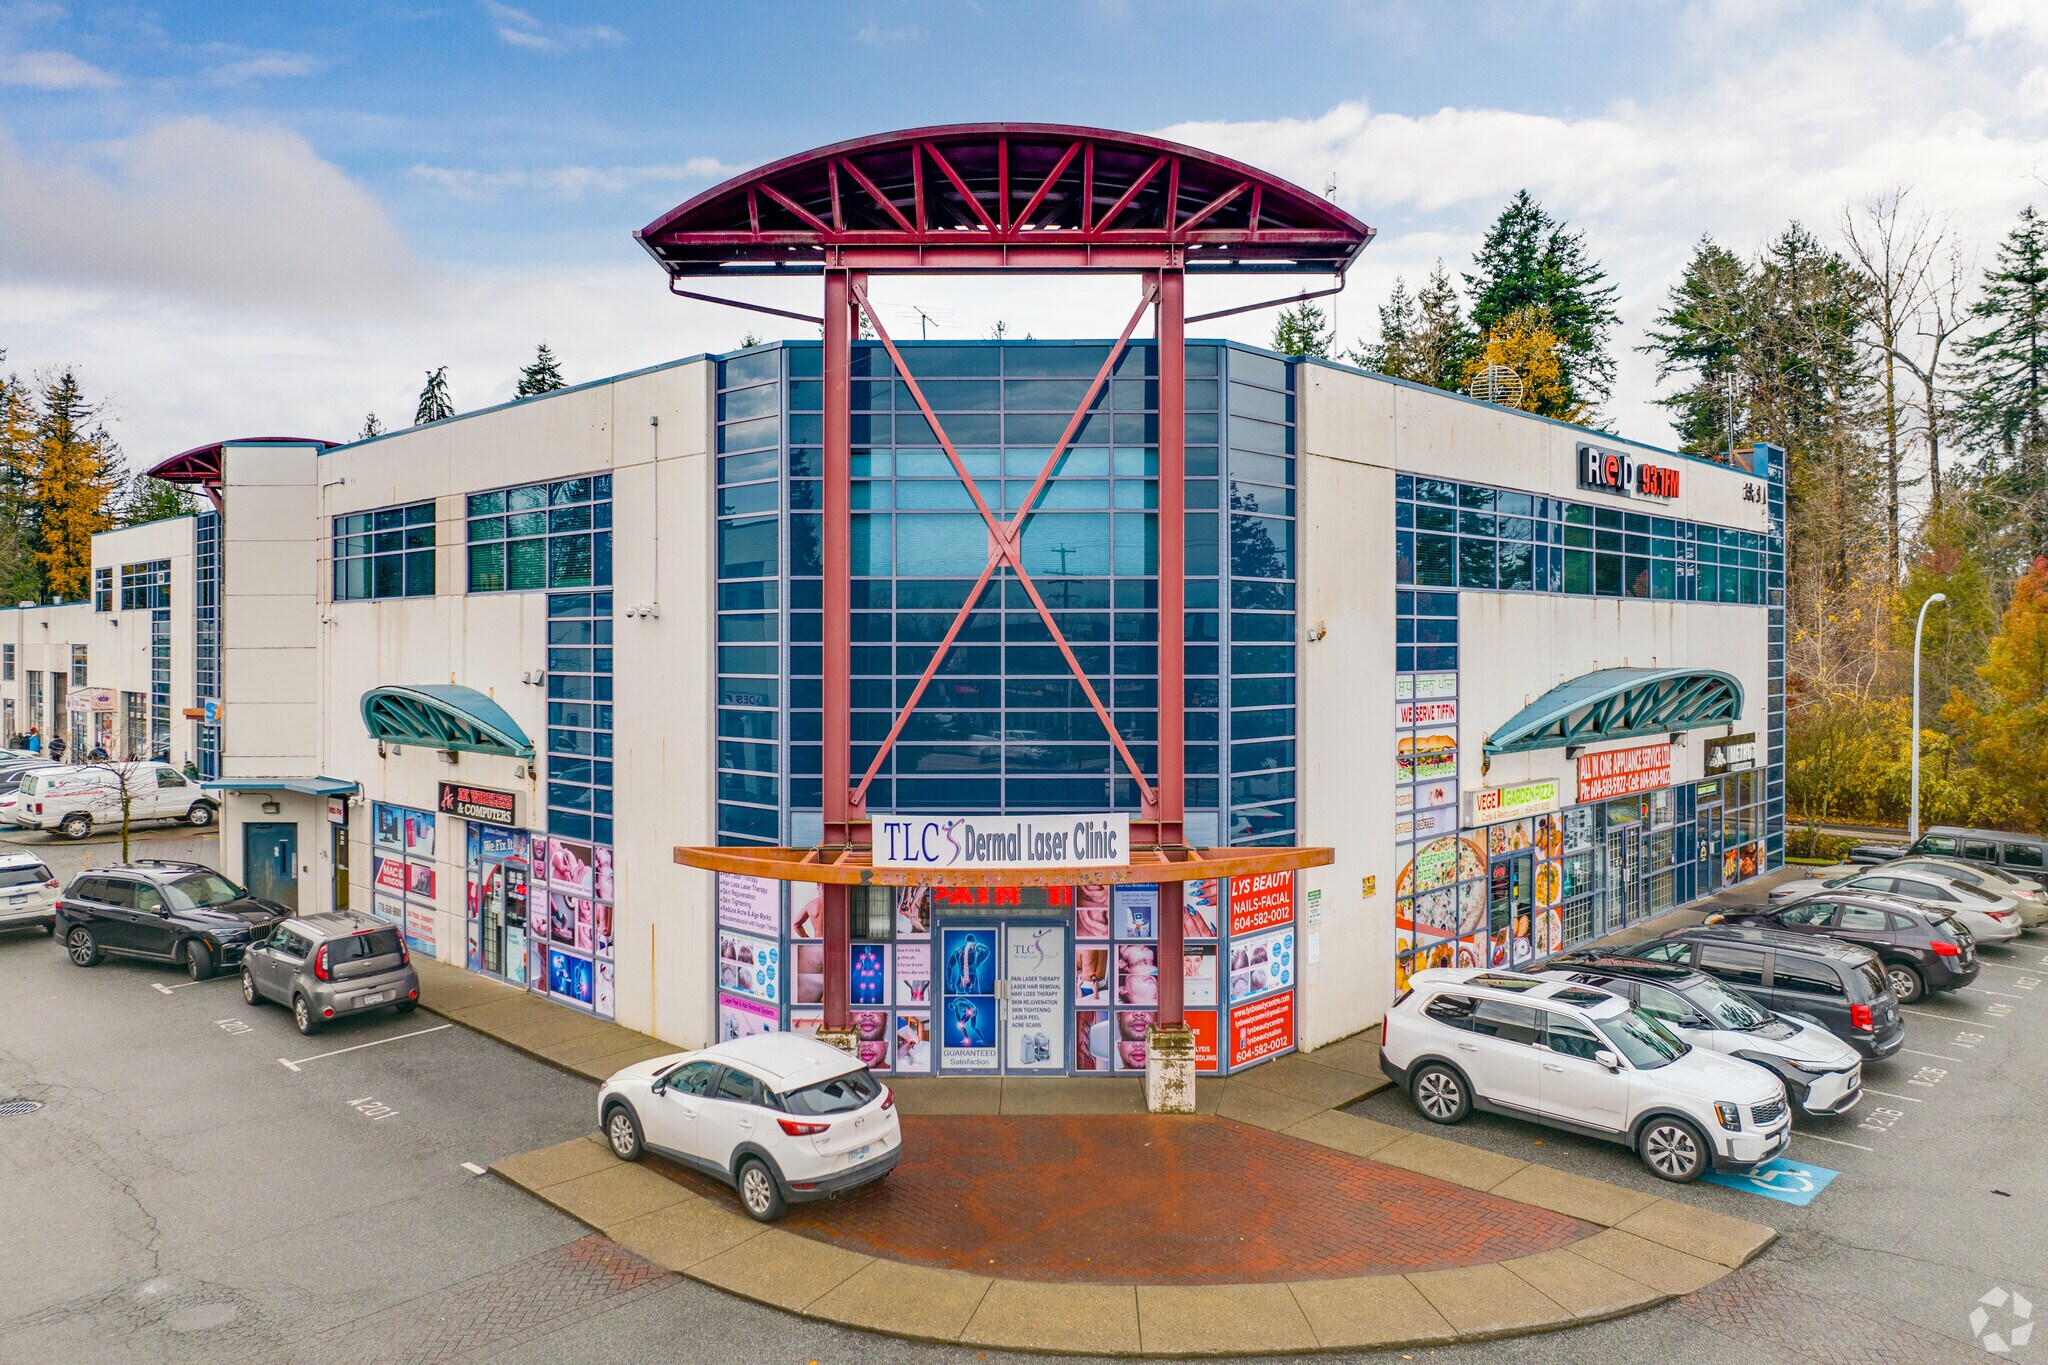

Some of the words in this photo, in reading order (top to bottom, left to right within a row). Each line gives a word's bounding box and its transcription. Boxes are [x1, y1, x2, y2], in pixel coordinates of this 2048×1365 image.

[1642, 463, 1680, 498] 93.1FM
[1401, 706, 1413, 723] WE
[1416, 705, 1435, 722] SERVE
[1437, 704, 1455, 719] TIFFIN
[1580, 757, 1591, 780] ALL
[1592, 755, 1598, 778] IN
[1600, 753, 1612, 776] ONE
[1613, 749, 1641, 774] APPLIANCE
[1642, 747, 1661, 769] SERVICE
[457, 787, 470, 803] AK
[471, 789, 512, 809] WIRELESS
[1476, 793, 1496, 811] VEGE
[1505, 785, 1534, 807] GARDEN
[1535, 783, 1555, 800] PIZZA
[457, 802, 464, 814] &
[464, 803, 511, 823] COMPUTERS
[1396, 821, 1412, 834] STYLE
[1416, 817, 1434, 830] COFFEE
[483, 840, 495, 852] We
[496, 839, 507, 851] Fix
[508, 838, 514, 850] It
[884, 822, 939, 861] TLC
[965, 823, 1021, 862] Dermal
[1028, 823, 1068, 861] Laser
[1073, 820, 1117, 860] Clinic
[1418, 850, 1455, 867] VEGETARIAN
[383, 864, 398, 878] MAC
[1418, 867, 1435, 880] PIZZA
[1231, 879, 1250, 896] LYS
[1253, 870, 1292, 892] BEAUTY
[1233, 891, 1290, 914] NAILS-FACIAL
[1234, 906, 1290, 931] 604-582-0012
[1013, 944, 1034, 954] TLC
[214, 1018, 254, 1035] A201
[1247, 1017, 1284, 1035] lysbeautycentre
[1247, 1028, 1282, 1045] lysbeautysalon
[1236, 1036, 1288, 1062] 604-582-0012
[346, 1096, 399, 1120] A201
